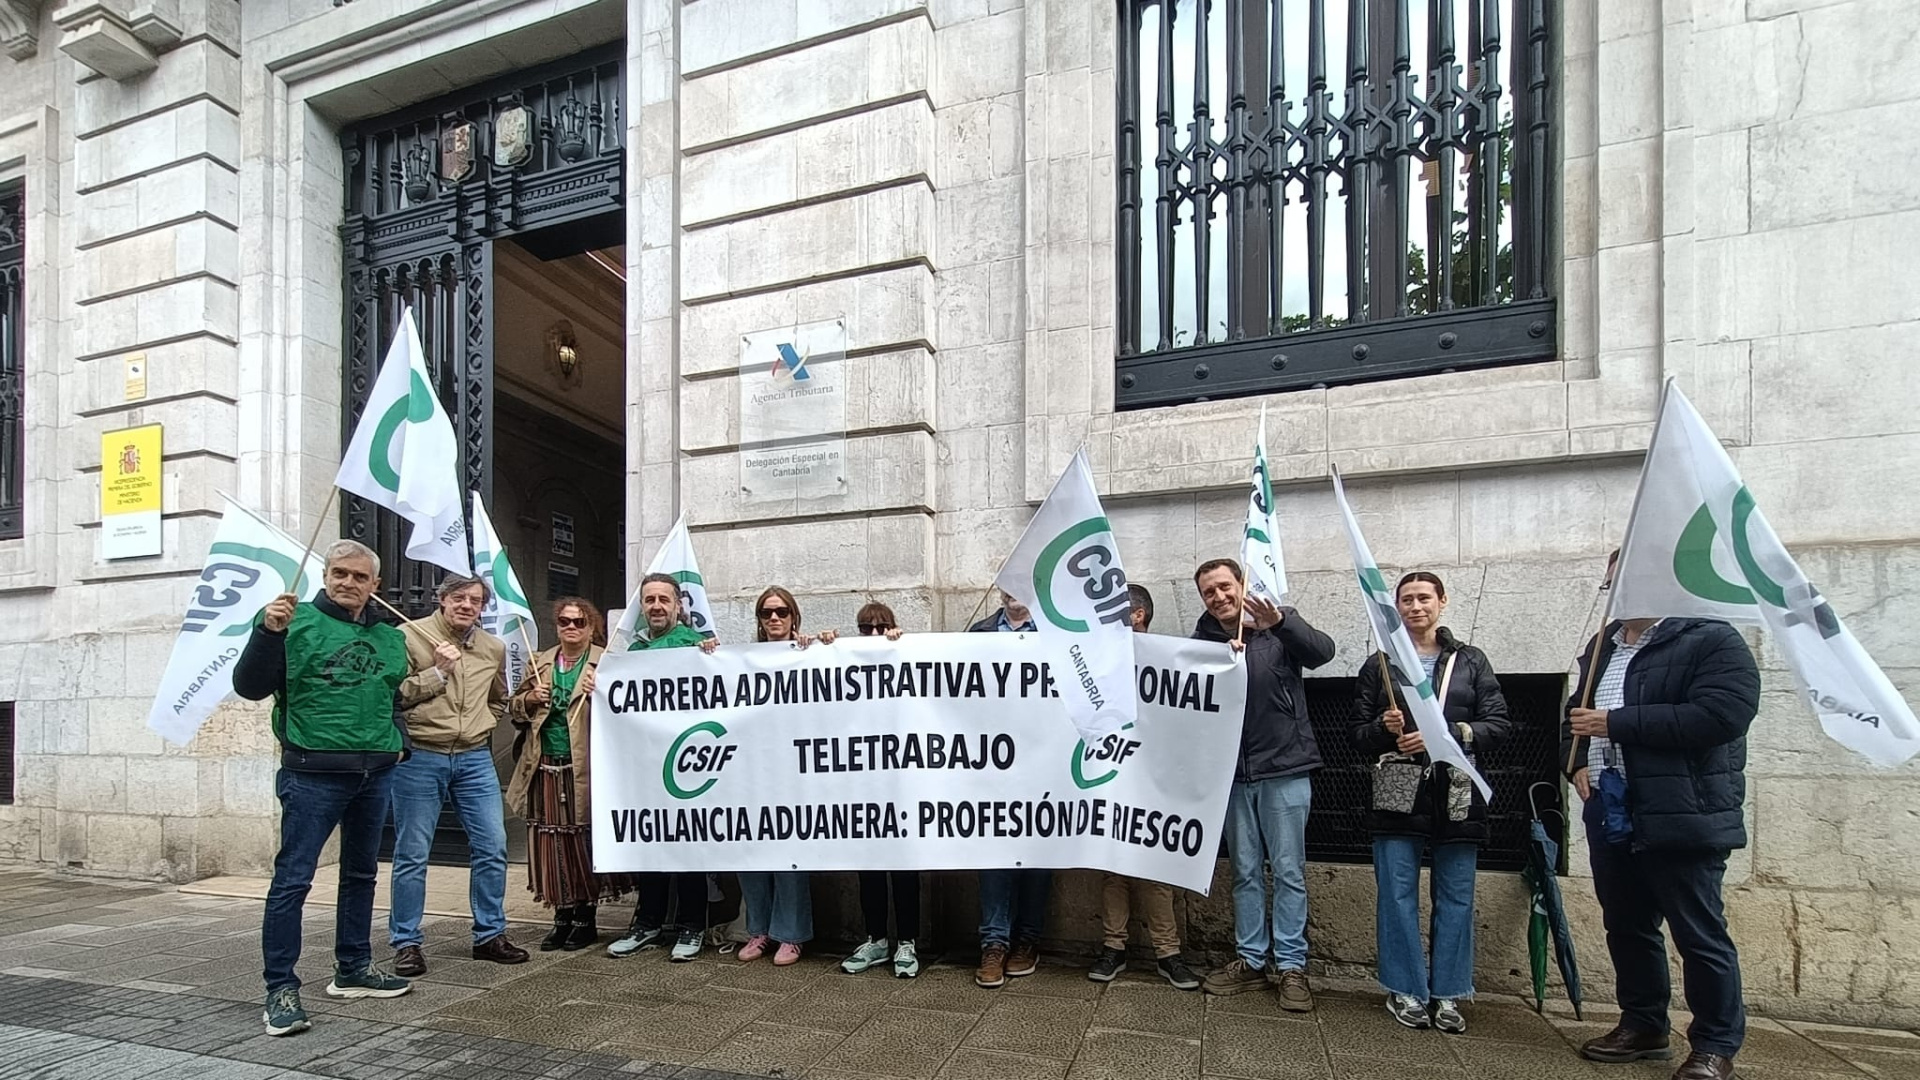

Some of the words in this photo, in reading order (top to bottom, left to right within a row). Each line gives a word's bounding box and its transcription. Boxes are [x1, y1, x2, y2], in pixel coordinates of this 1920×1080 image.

[751, 391, 786, 406] Agencia
[789, 385, 834, 399] Tributaria
[745, 456, 790, 469] Delegación
[792, 452, 826, 466] Especial
[829, 452, 839, 460] en
[772, 466, 811, 478] Cantabria
[608, 674, 728, 714] CARRERA
[734, 662, 986, 707] ADMINISTRATIVA
[992, 662, 1012, 698] Y
[1020, 662, 1220, 713] PRONAL
[1069, 644, 1105, 711] CANTABRIA
[677, 745, 738, 773] CSIF
[793, 733, 1015, 774] TELETRABAJO
[611, 806, 752, 843] VIGILANCIA
[757, 802, 908, 841] ADUANERA:
[918, 791, 1073, 838] PROFESIÓN
[1076, 798, 1107, 836] DE
[1112, 802, 1203, 857] RIESGO
